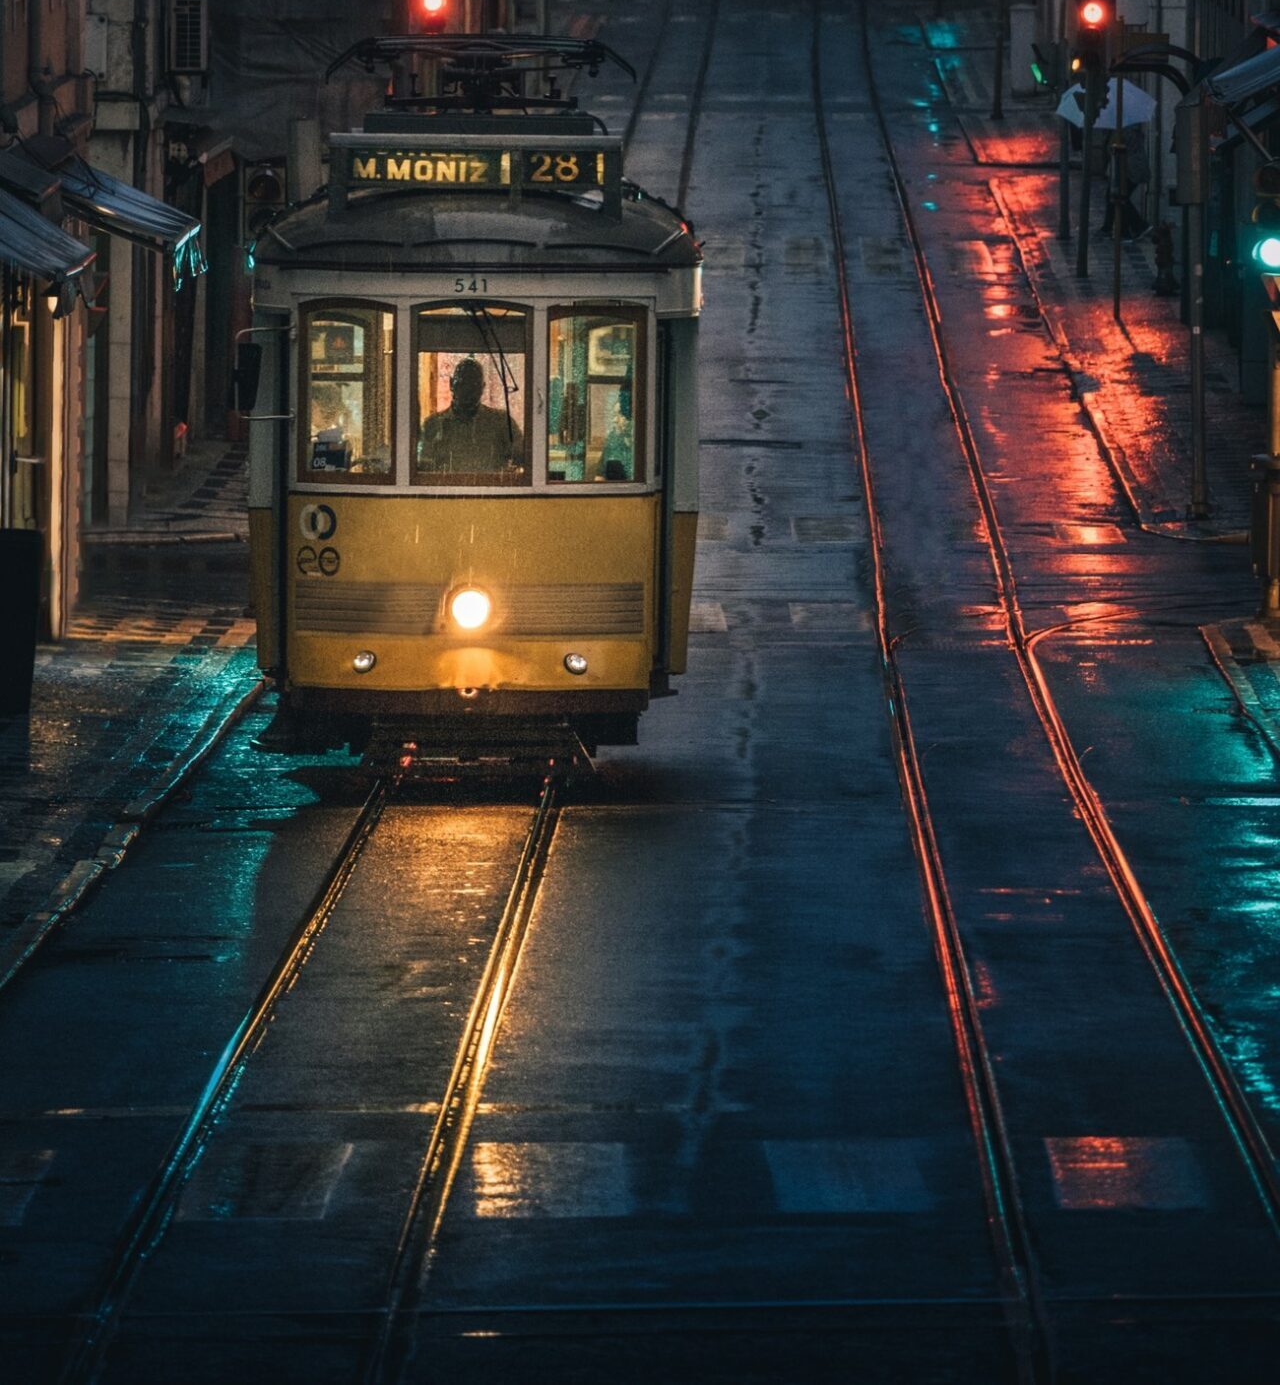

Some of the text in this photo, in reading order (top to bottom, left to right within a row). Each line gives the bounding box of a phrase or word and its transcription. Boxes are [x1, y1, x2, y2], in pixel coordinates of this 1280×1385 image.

[353, 157, 489, 183] M. MONIZ
[531, 153, 579, 182] 28
[455, 278, 487, 293] 541
